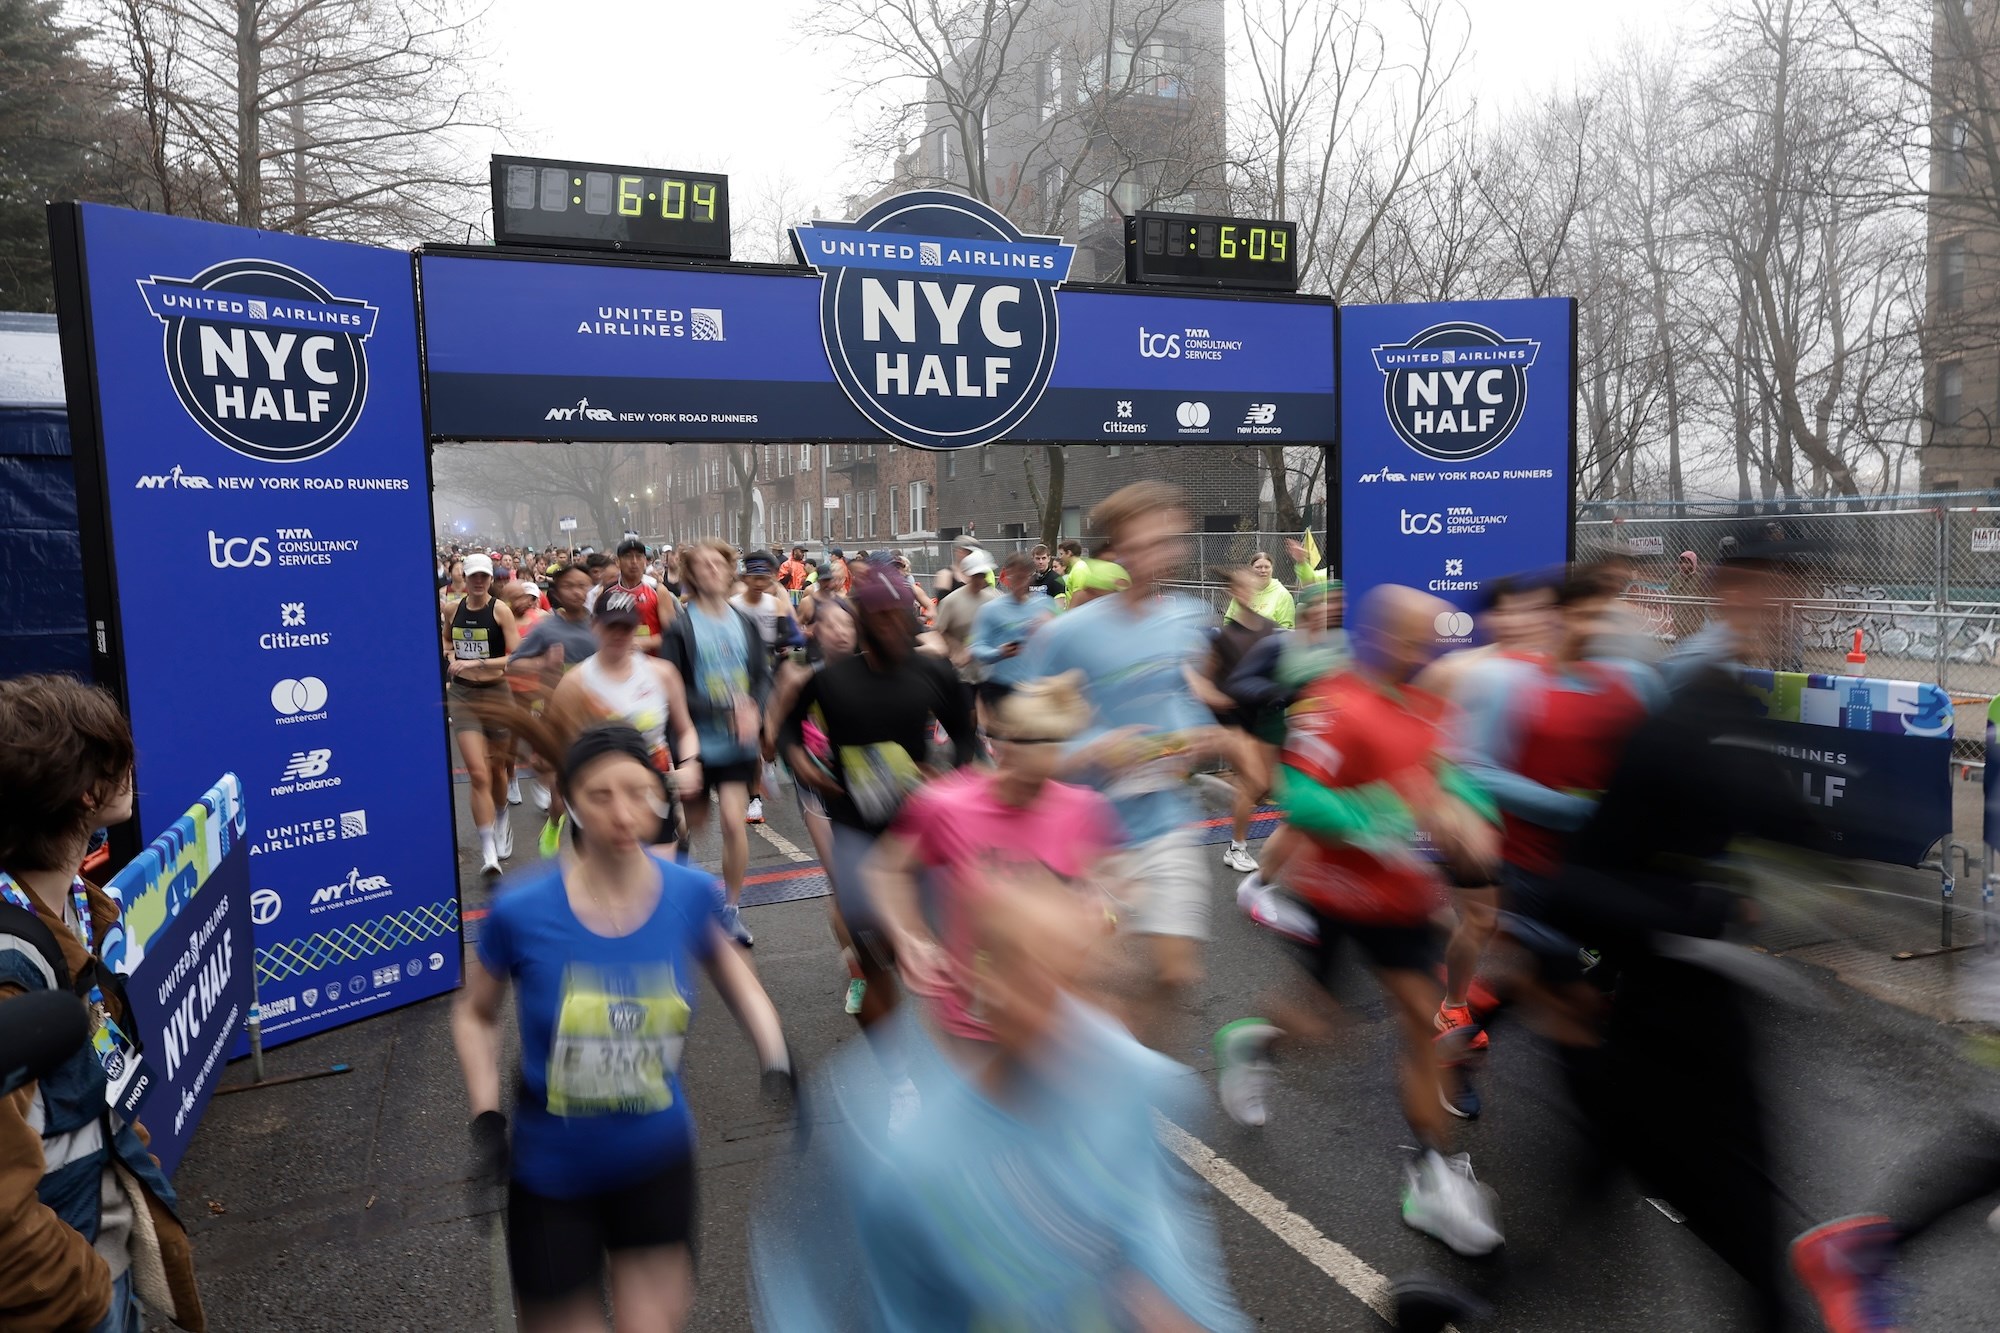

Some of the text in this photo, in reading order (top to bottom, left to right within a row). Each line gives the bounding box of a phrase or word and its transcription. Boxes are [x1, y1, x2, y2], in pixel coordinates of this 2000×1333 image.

[821, 240, 1054, 269] UNITED AIRLINES
[162, 293, 361, 326] UNITED AIRLINES
[598, 306, 684, 322] UNITED
[862, 277, 1022, 348] NYC
[577, 321, 685, 338] AIRLINES
[1184, 328, 1210, 338] TATA
[1139, 326, 1181, 359] tcs
[1184, 339, 1243, 351] CONSULTANCY
[199, 325, 338, 385] NYC
[1184, 350, 1222, 360] SERVICES
[1386, 350, 1526, 364] UNITED AIRLINES
[875, 352, 1011, 398] HALF
[1407, 369, 1504, 407] NYC
[214, 384, 331, 423] HALF
[619, 412, 645, 422] NEW
[647, 412, 677, 422] YORK
[679, 413, 708, 423] ROAD
[711, 414, 758, 424] RUNNERS
[1414, 408, 1496, 434] HALF
[1102, 421, 1147, 434] Citizens
[1252, 425, 1282, 435] balance
[217, 476, 255, 490] NEW
[258, 477, 301, 490] YORK
[303, 478, 344, 490] ROAD
[347, 478, 409, 491] RUNNERS
[1410, 472, 1436, 482] NEW
[1438, 471, 1467, 481] YORK
[1469, 470, 1501, 480] ROAD
[1503, 469, 1553, 479] RUNNERS
[1446, 507, 1474, 515] TATA
[1400, 508, 1443, 535] tcs
[1446, 515, 1508, 525] CONSULTANCY
[276, 528, 313, 539] TATA
[1446, 524, 1486, 534] SERVICES
[208, 529, 272, 569] tcs
[277, 539, 359, 553] CONSULTANCY
[278, 553, 332, 566] SERVICES
[1428, 579, 1480, 591] Citizens
[259, 631, 331, 650] Citizens
[464, 641, 483, 653] 2175
[1435, 636, 1473, 644] mastercard
[275, 711, 328, 726] mastercard
[270, 776, 342, 797] new balance
[1802, 771, 1847, 808] LF
[265, 817, 336, 841] UNITED
[250, 829, 337, 857] AIRLINES
[309, 889, 393, 916] NEW YORK ROAD RUNNERS
[158, 894, 230, 1006] UNITED AIRLINES
[162, 927, 233, 1083] NYC HALF
[124, 1074, 149, 1112] PHOTO
